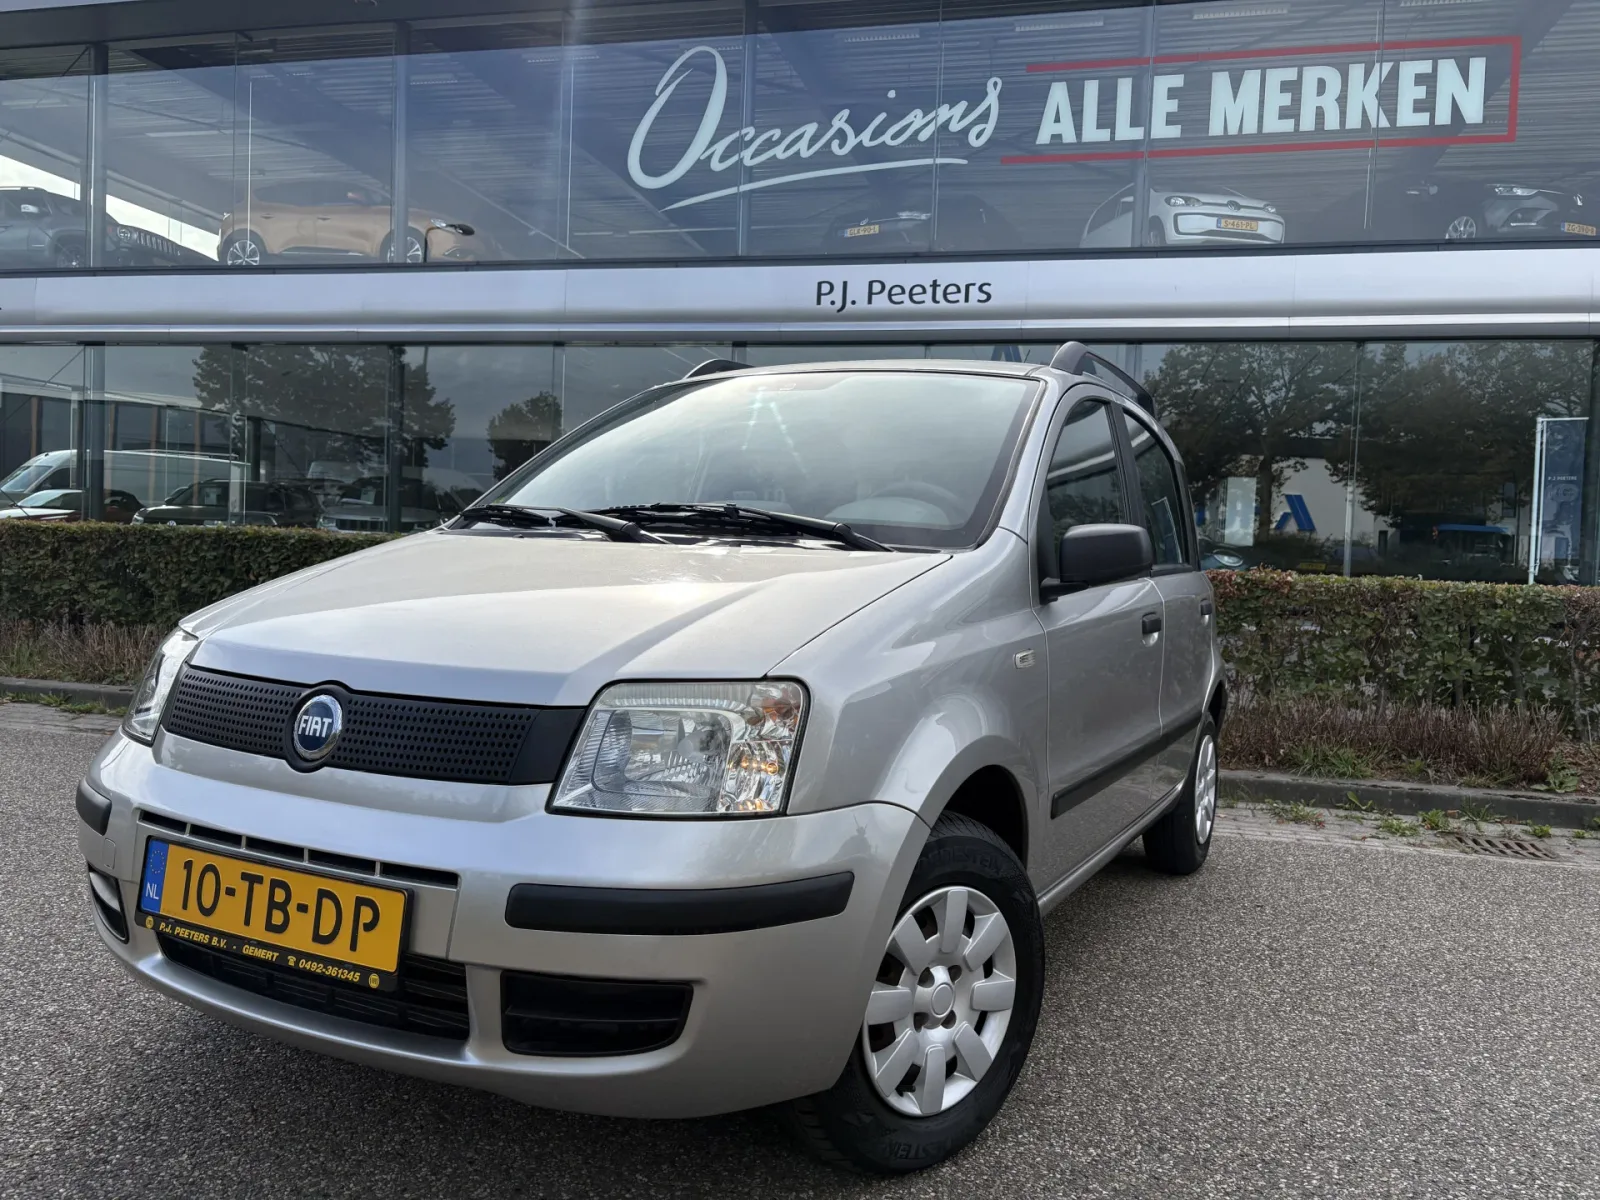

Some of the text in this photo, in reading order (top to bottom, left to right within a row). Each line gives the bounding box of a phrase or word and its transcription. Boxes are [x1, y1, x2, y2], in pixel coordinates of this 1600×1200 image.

[627, 45, 1003, 189] Occasions
[1035, 56, 1487, 145] ALLE MERKEN
[816, 279, 992, 313] P.J. Peeters
[298, 715, 333, 738] FIAT
[145, 882, 160, 900] NL
[181, 859, 381, 953] 10-TB-DP
[160, 922, 361, 982] P.J. PEETERS B.V. GEMERT 0492-361345
